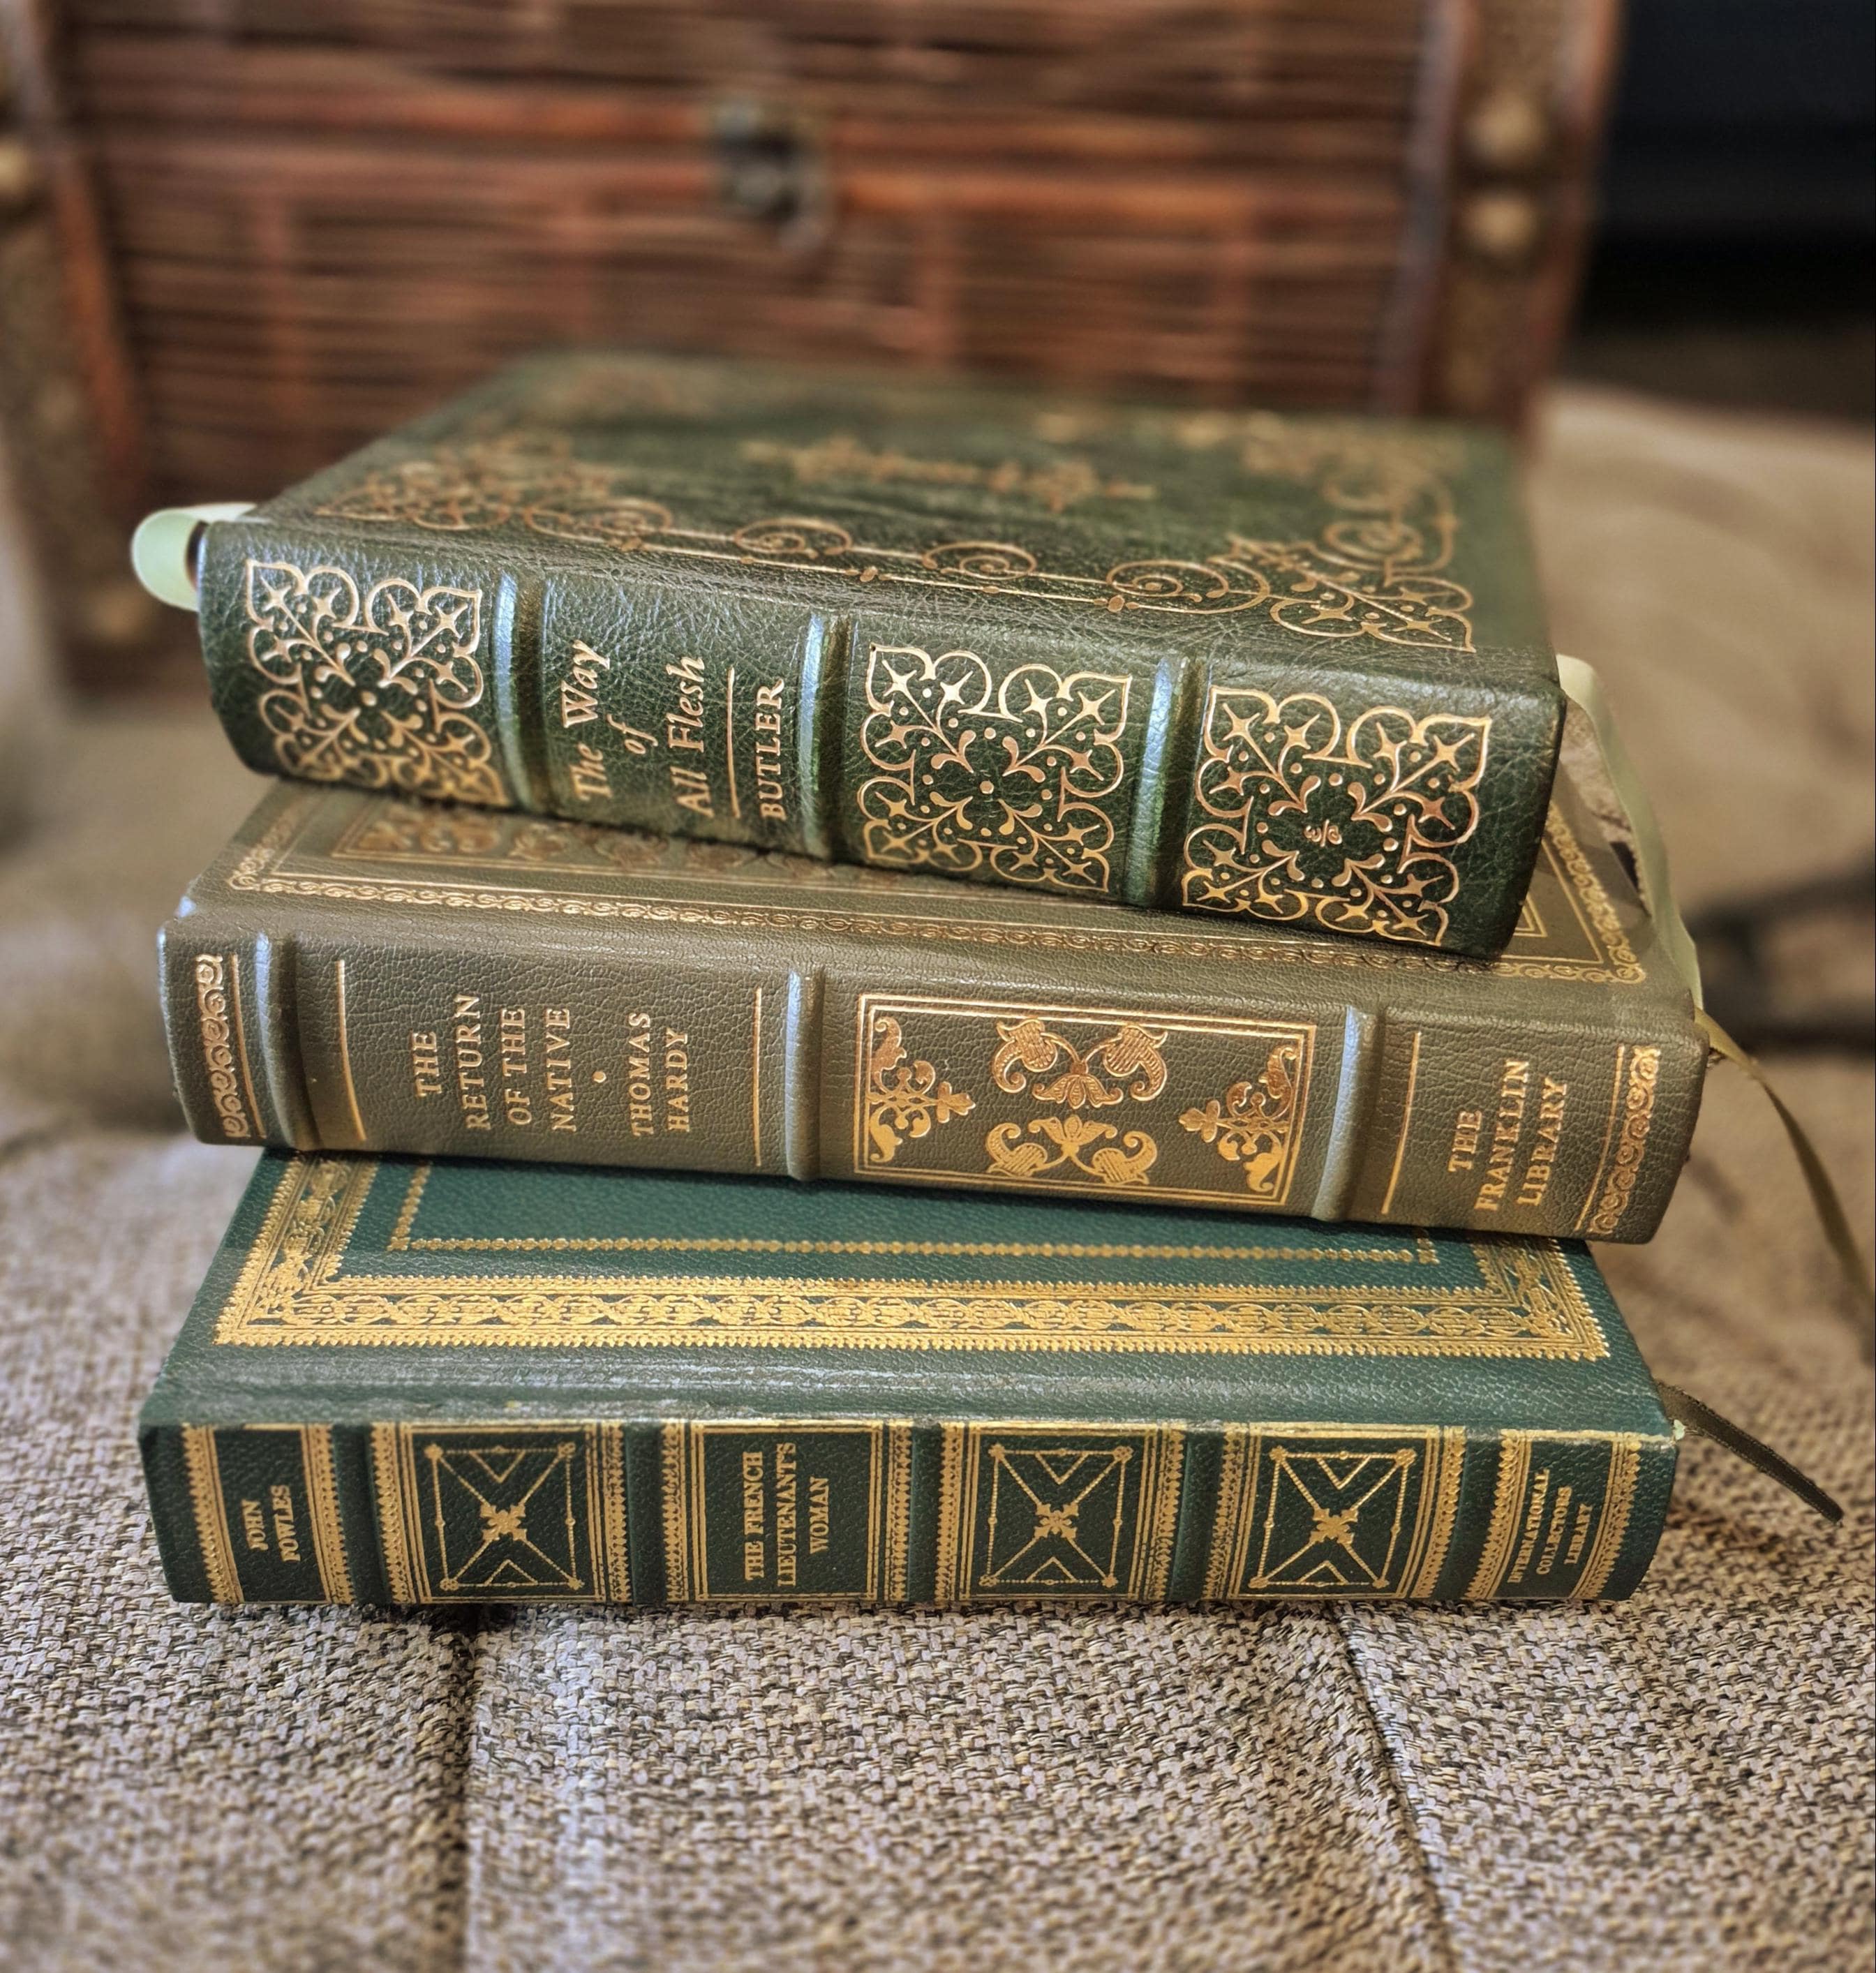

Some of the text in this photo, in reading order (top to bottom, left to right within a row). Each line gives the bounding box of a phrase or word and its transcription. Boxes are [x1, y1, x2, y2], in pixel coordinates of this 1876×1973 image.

[561, 639, 613, 802] The Way
[606, 713, 658, 754] of
[666, 655, 715, 819] All Flesh
[755, 678, 787, 821] BUTLER
[412, 1031, 442, 1098] THE
[454, 994, 491, 1131] RETURN
[501, 1008, 532, 1126] OF THE
[545, 1008, 576, 1132] NATIVE
[629, 1012, 654, 1137] THOMAS
[666, 1027, 690, 1133] HARDY
[1448, 1110, 1482, 1172] THE
[1474, 1059, 1529, 1211] FRANKLIN
[1517, 1077, 1567, 1206] LIBRARY
[241, 1499, 269, 1551] JOHN
[270, 1484, 301, 1562] FOWLES
[743, 1451, 765, 1581] THE FRENCH
[775, 1442, 797, 1587] LIEUTENANT'S
[810, 1476, 829, 1554] WOMAN
[1507, 1468, 1550, 1583] INTERNATIONAL
[1536, 1486, 1572, 1574] COLLECTORS
[1563, 1503, 1593, 1564] LIBRARY
